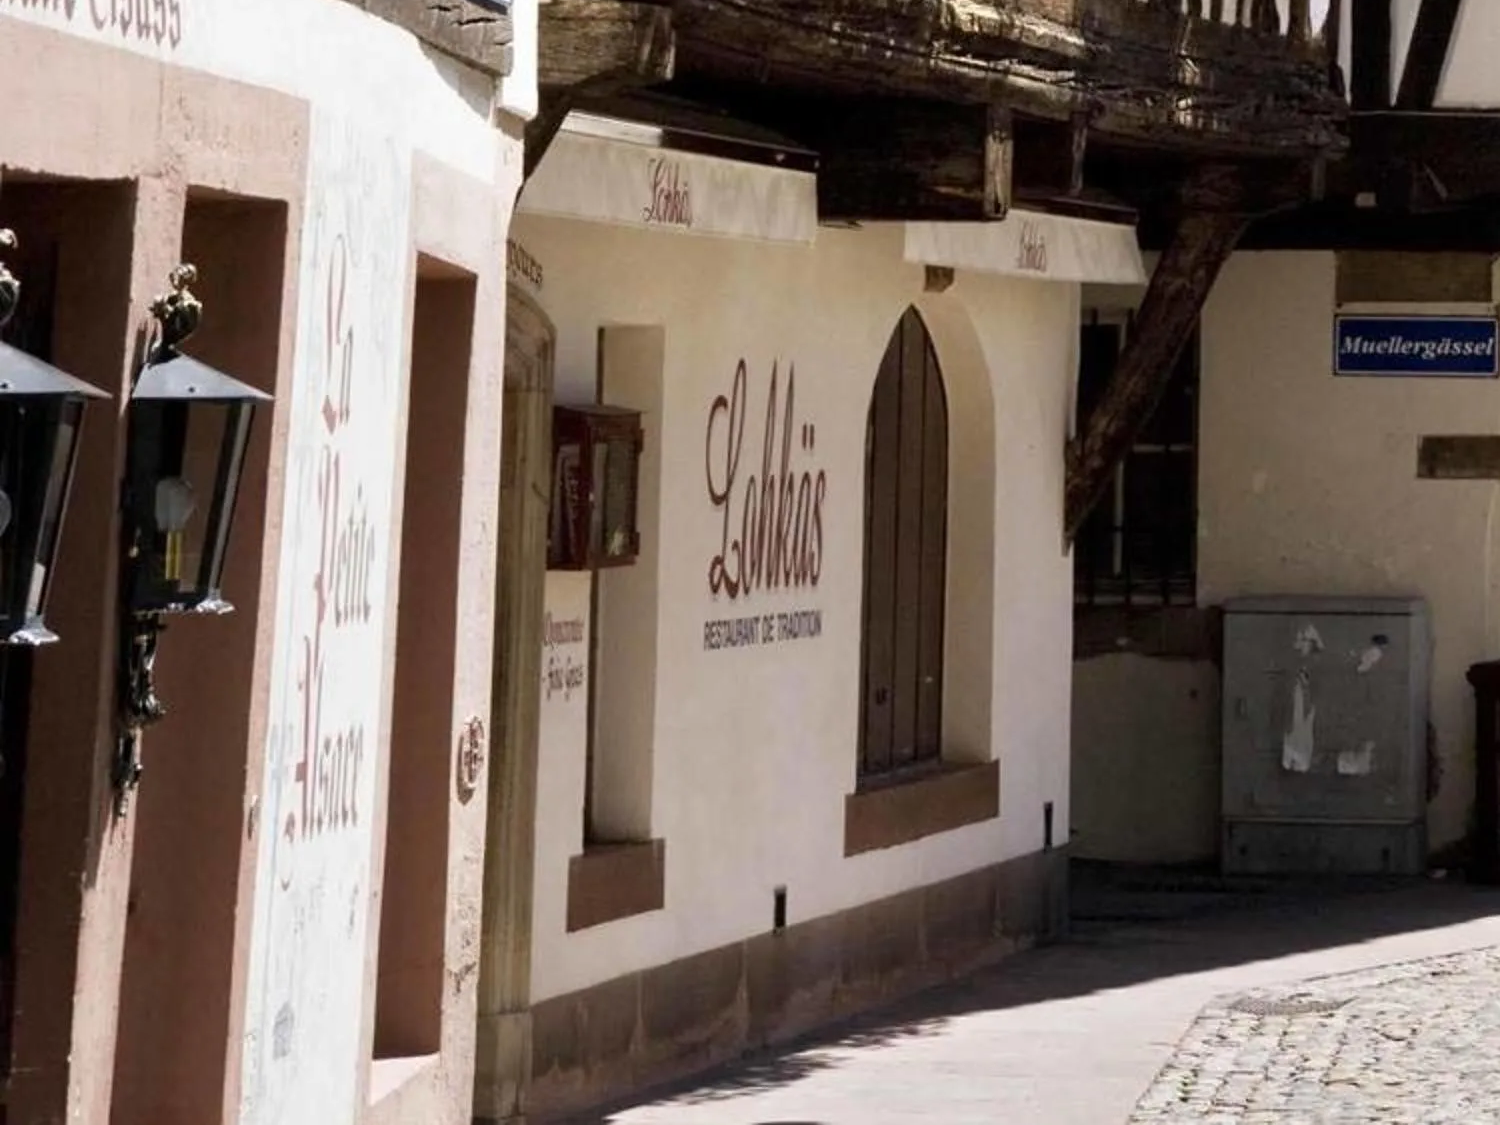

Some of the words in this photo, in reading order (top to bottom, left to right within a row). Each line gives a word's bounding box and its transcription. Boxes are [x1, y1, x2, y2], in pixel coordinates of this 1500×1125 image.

[1339, 335, 1496, 360] Muellergässel
[705, 356, 826, 600] Lohkäs
[703, 616, 760, 651] RESTAURANT
[761, 614, 775, 644] DE
[777, 609, 823, 642] TRADITION
